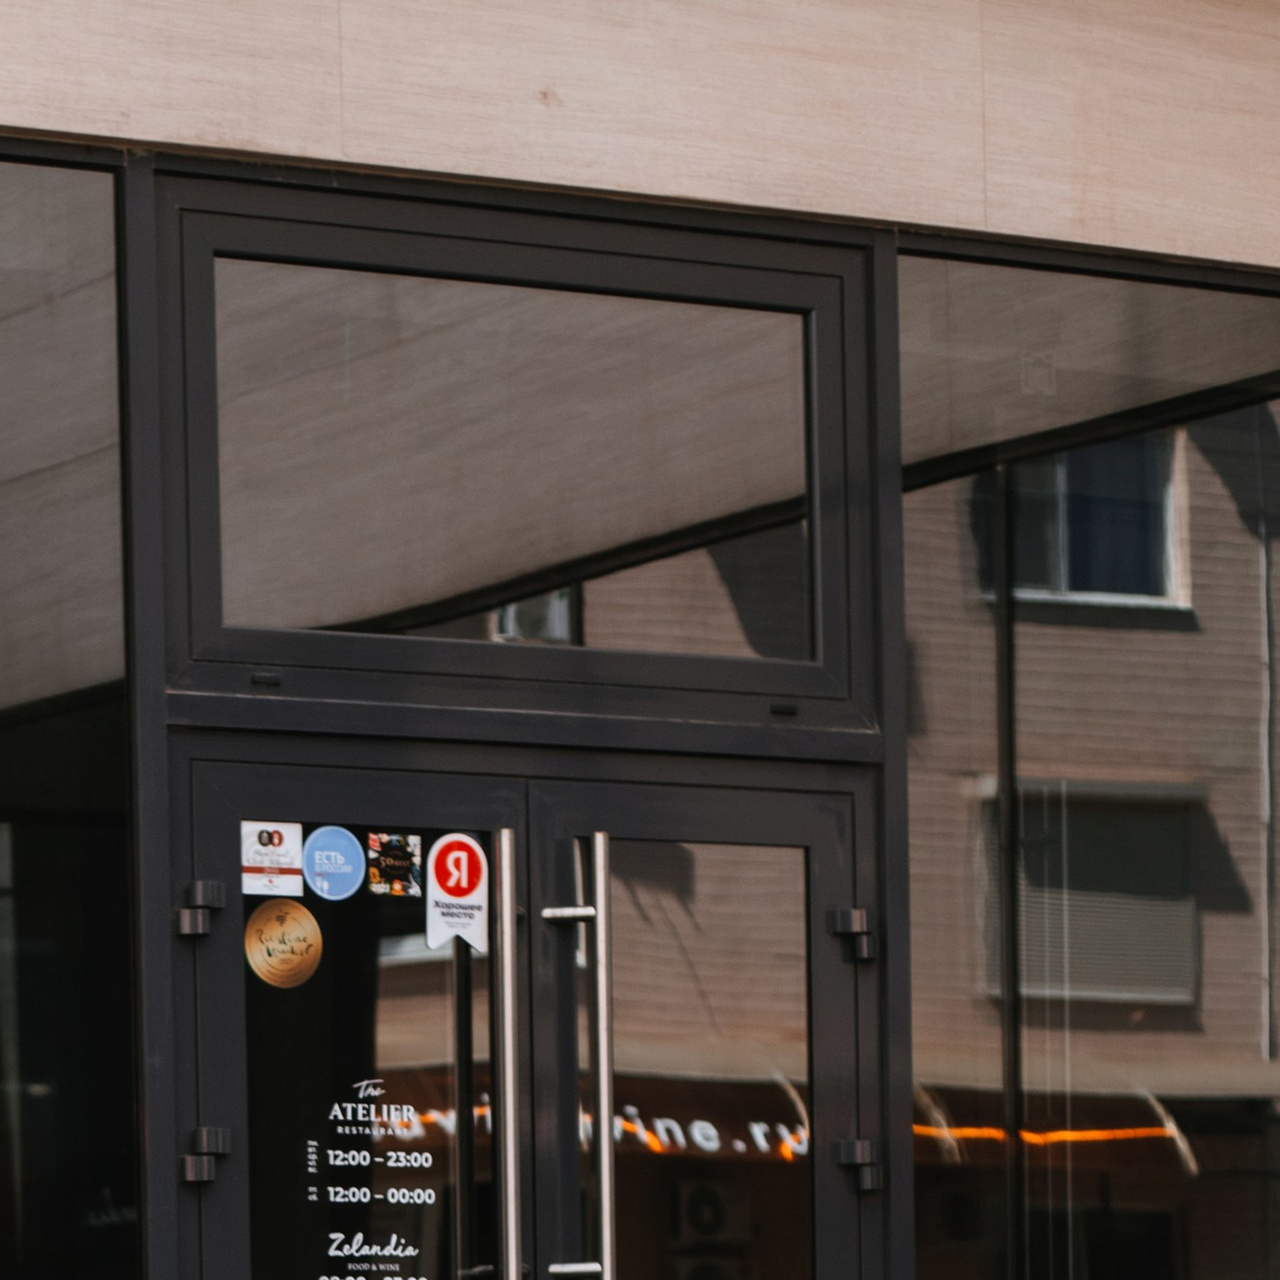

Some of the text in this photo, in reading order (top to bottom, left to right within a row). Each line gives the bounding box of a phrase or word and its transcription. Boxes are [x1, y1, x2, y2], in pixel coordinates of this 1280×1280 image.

[314, 850, 345, 864] ЕСТЬ
[445, 850, 469, 888] Я
[433, 899, 483, 912] Хорошее
[441, 910, 476, 920] место
[352, 1079, 386, 1099] The
[328, 1102, 416, 1122] ATELIER
[336, 1126, 408, 1136] RESTAURANT
[327, 1150, 371, 1167] 12:00
[386, 1151, 433, 1168] 23:00
[327, 1186, 371, 1203] 12:00
[387, 1188, 436, 1204] 00:00
[328, 1232, 419, 1257] Zelandia
[348, 1263, 370, 1271] FOOD
[379, 1263, 400, 1272] WINE
